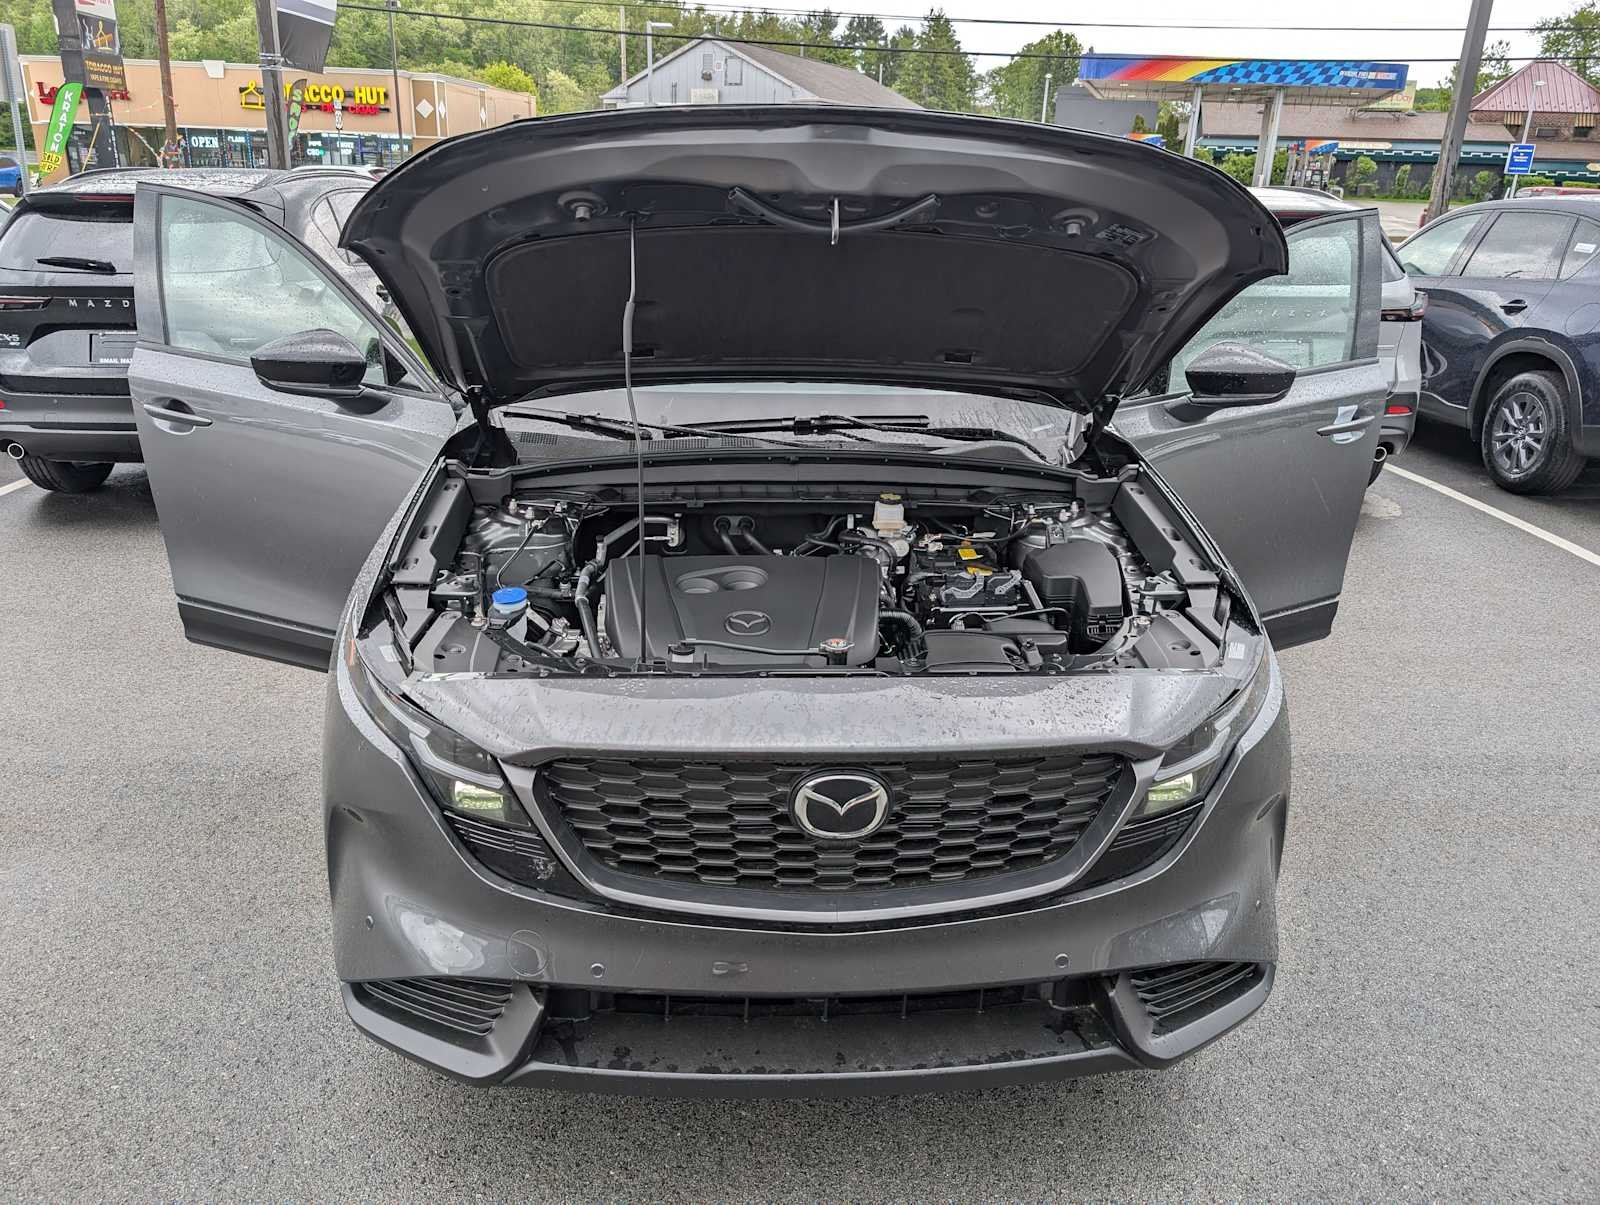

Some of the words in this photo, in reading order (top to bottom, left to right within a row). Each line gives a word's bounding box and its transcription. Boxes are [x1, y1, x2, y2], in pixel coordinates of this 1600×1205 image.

[354, 86, 385, 105] HUT
[191, 136, 219, 148] OPEN
[390, 143, 408, 152] OPN
[68, 299, 131, 308] MAZD
